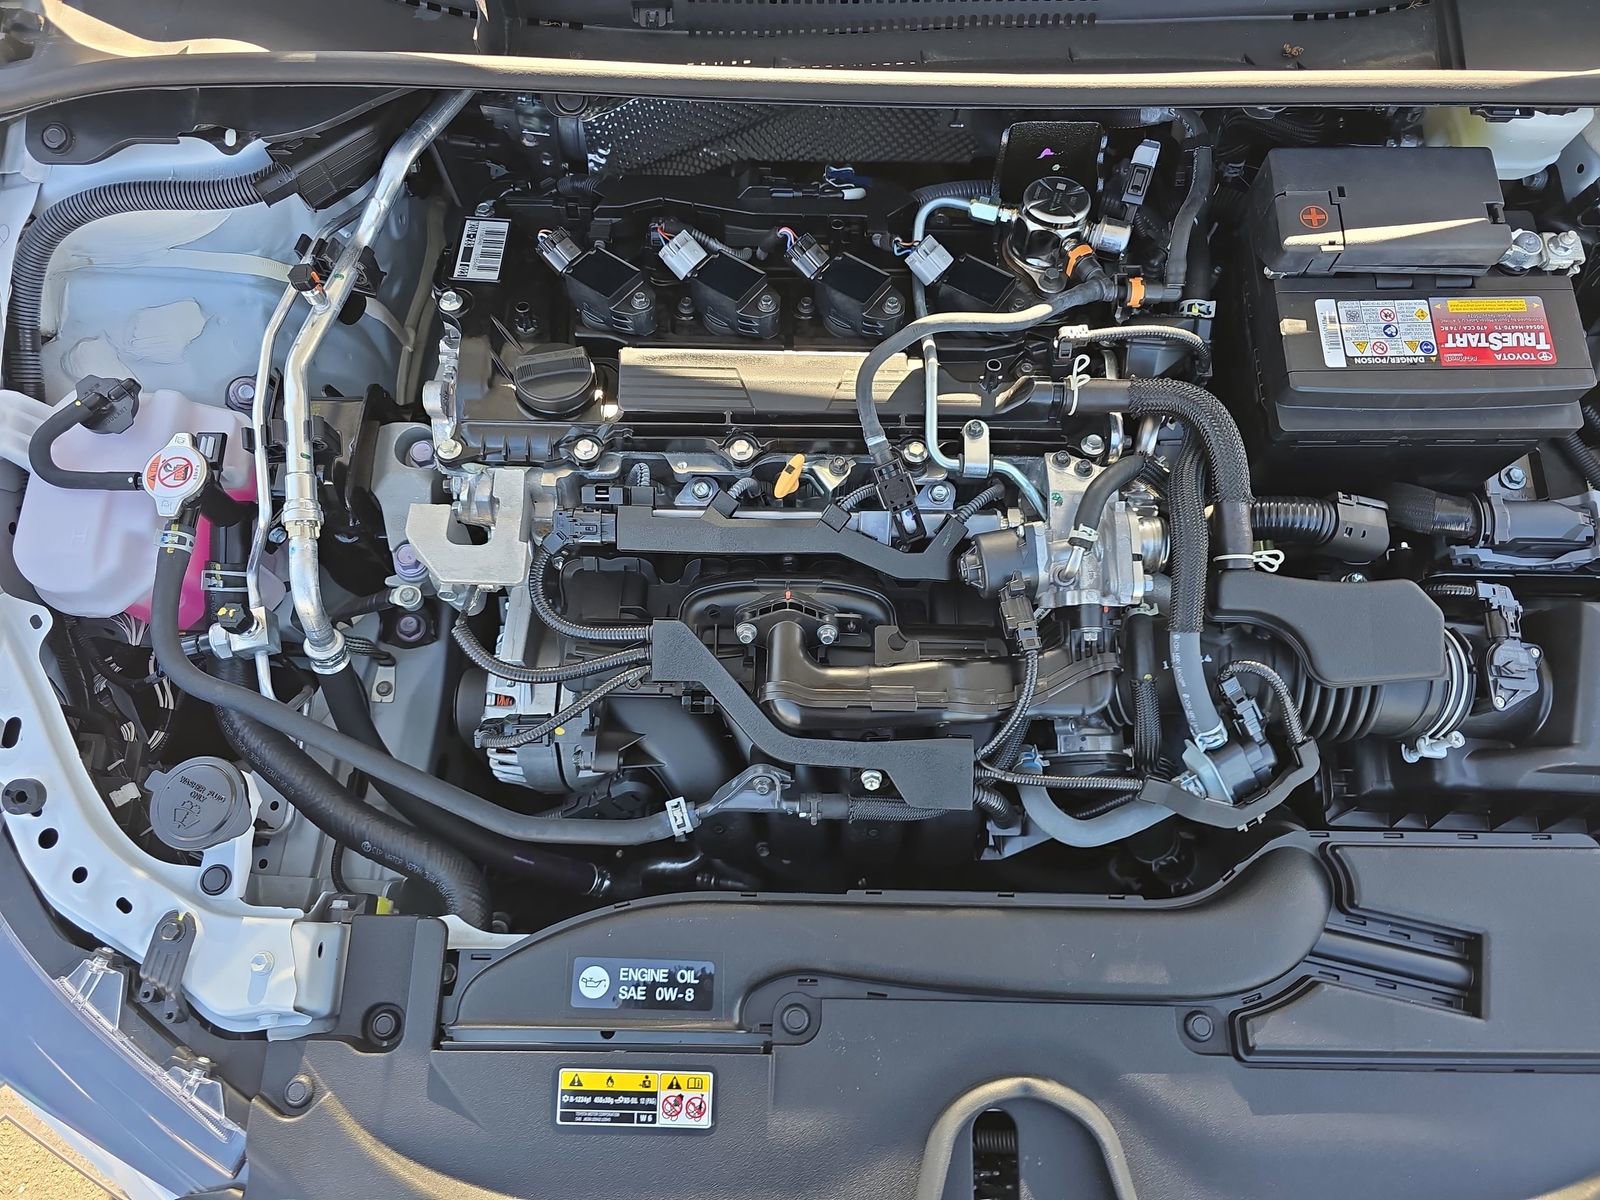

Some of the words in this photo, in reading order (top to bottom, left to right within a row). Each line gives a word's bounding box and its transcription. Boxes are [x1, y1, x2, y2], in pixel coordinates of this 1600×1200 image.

[180, 776, 206, 792] WASHER
[207, 790, 226, 803] FLUID
[190, 791, 206, 803] ONLY
[620, 968, 668, 983] ENGINE
[676, 970, 699, 984] OIL
[618, 986, 646, 1000] SAE
[655, 987, 694, 1002] 0W-8
